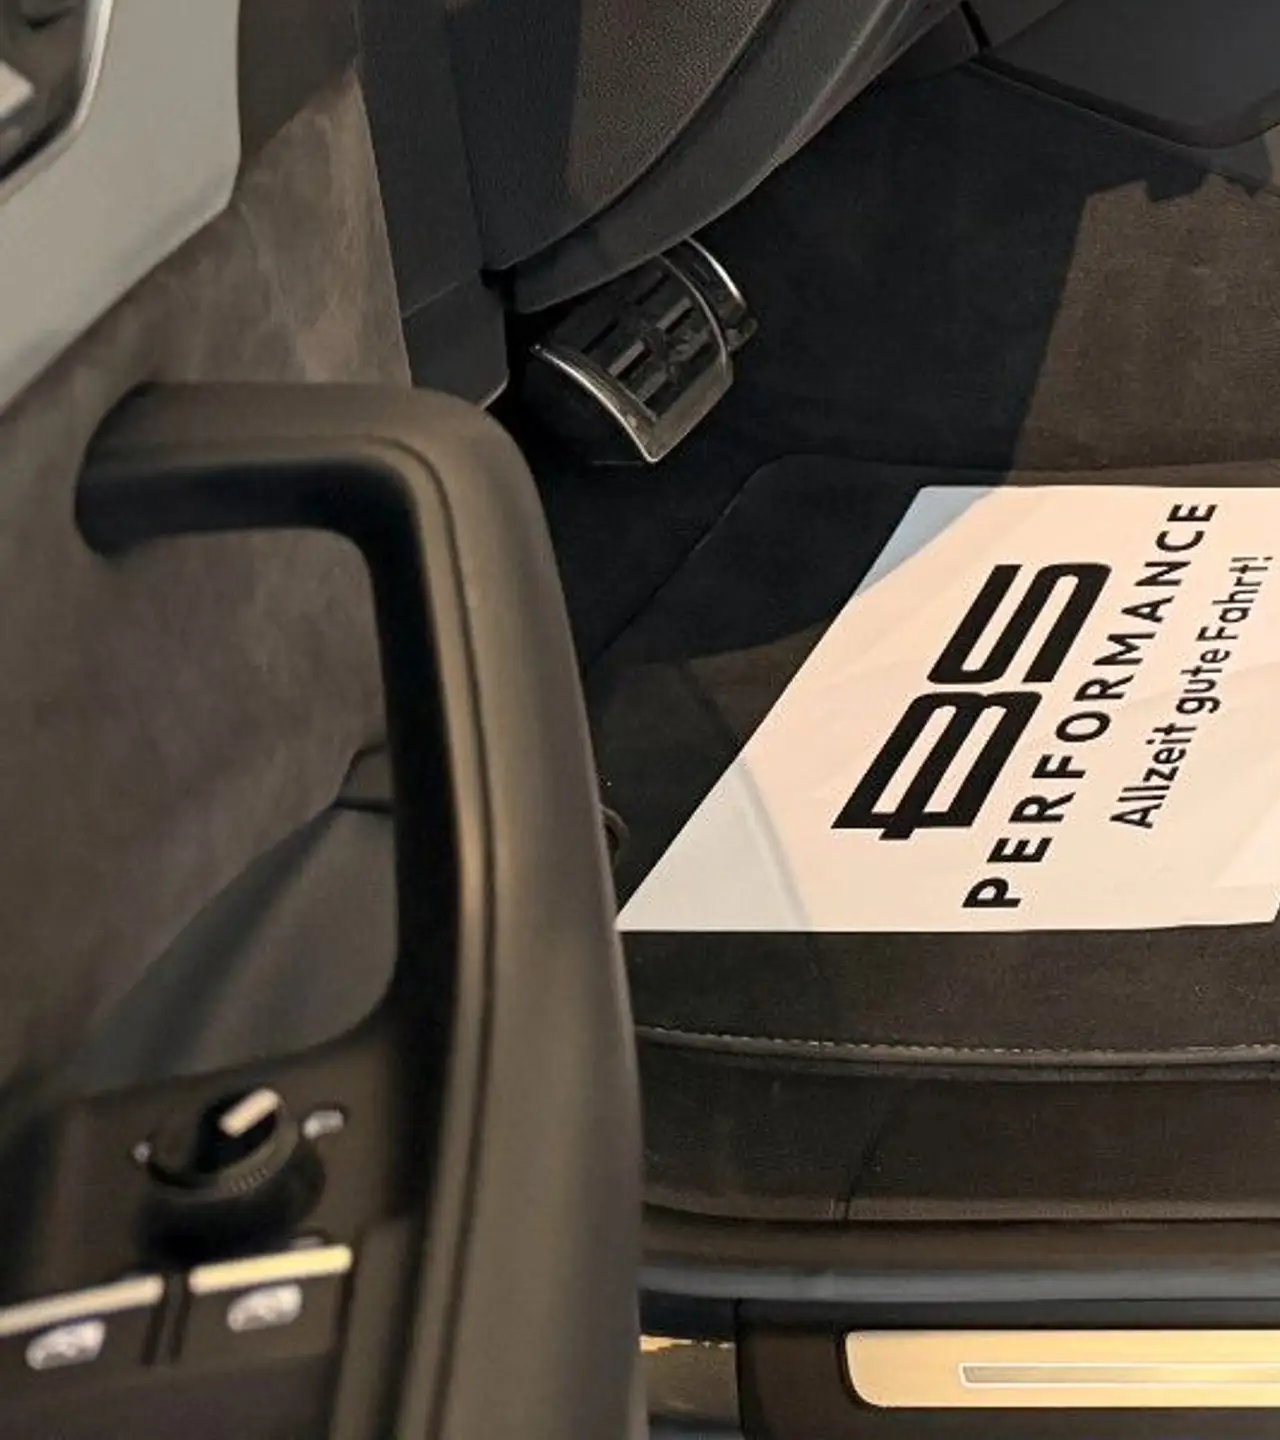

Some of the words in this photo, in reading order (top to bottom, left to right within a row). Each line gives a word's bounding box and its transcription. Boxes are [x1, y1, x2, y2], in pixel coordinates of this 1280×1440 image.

[1196, 556, 1273, 642] Fahrt!
[962, 504, 1217, 909] PERFORMANCE
[1175, 648, 1231, 715] gute
[1109, 722, 1197, 829] Allzeit
